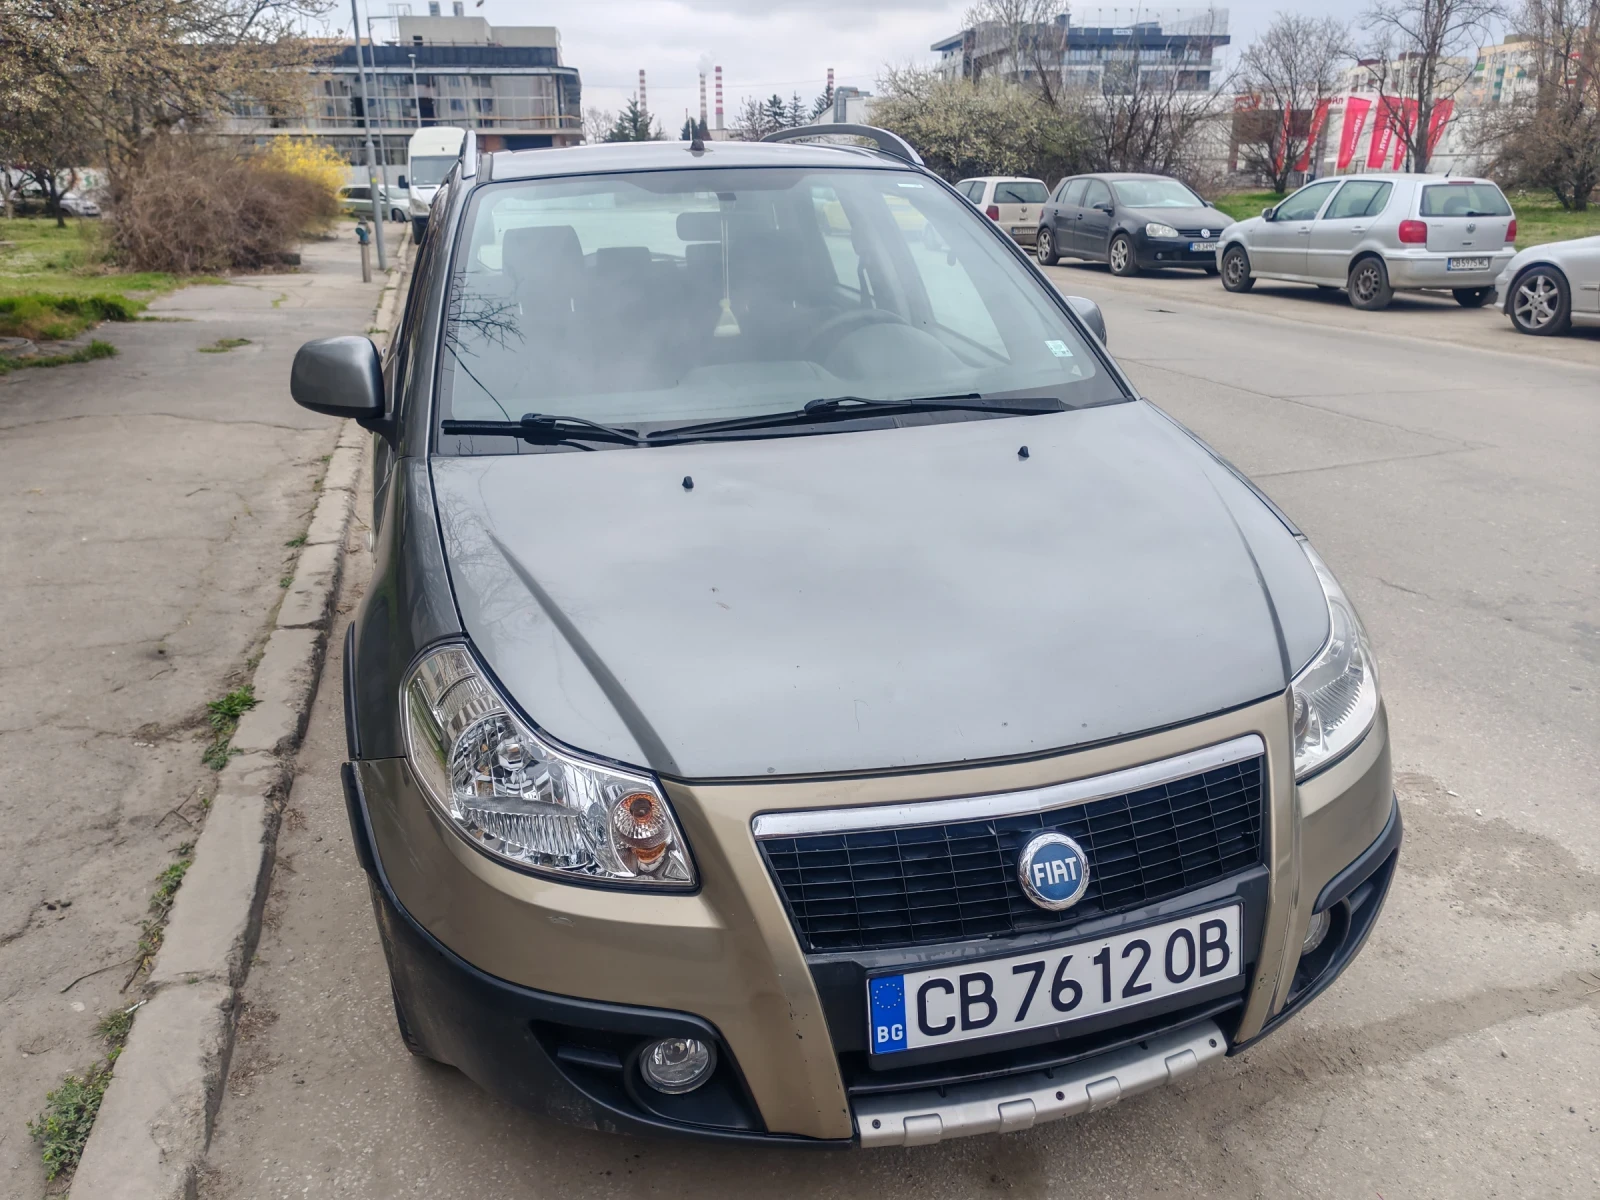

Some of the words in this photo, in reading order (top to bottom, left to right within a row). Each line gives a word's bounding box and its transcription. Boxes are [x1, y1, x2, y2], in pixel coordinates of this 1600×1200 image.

[1452, 258, 1460, 267] CB
[1033, 856, 1078, 887] FIAT
[917, 972, 998, 1036] CB
[1012, 939, 1152, 1022] 7612
[1165, 919, 1231, 984] OB
[877, 1023, 903, 1043] BG
